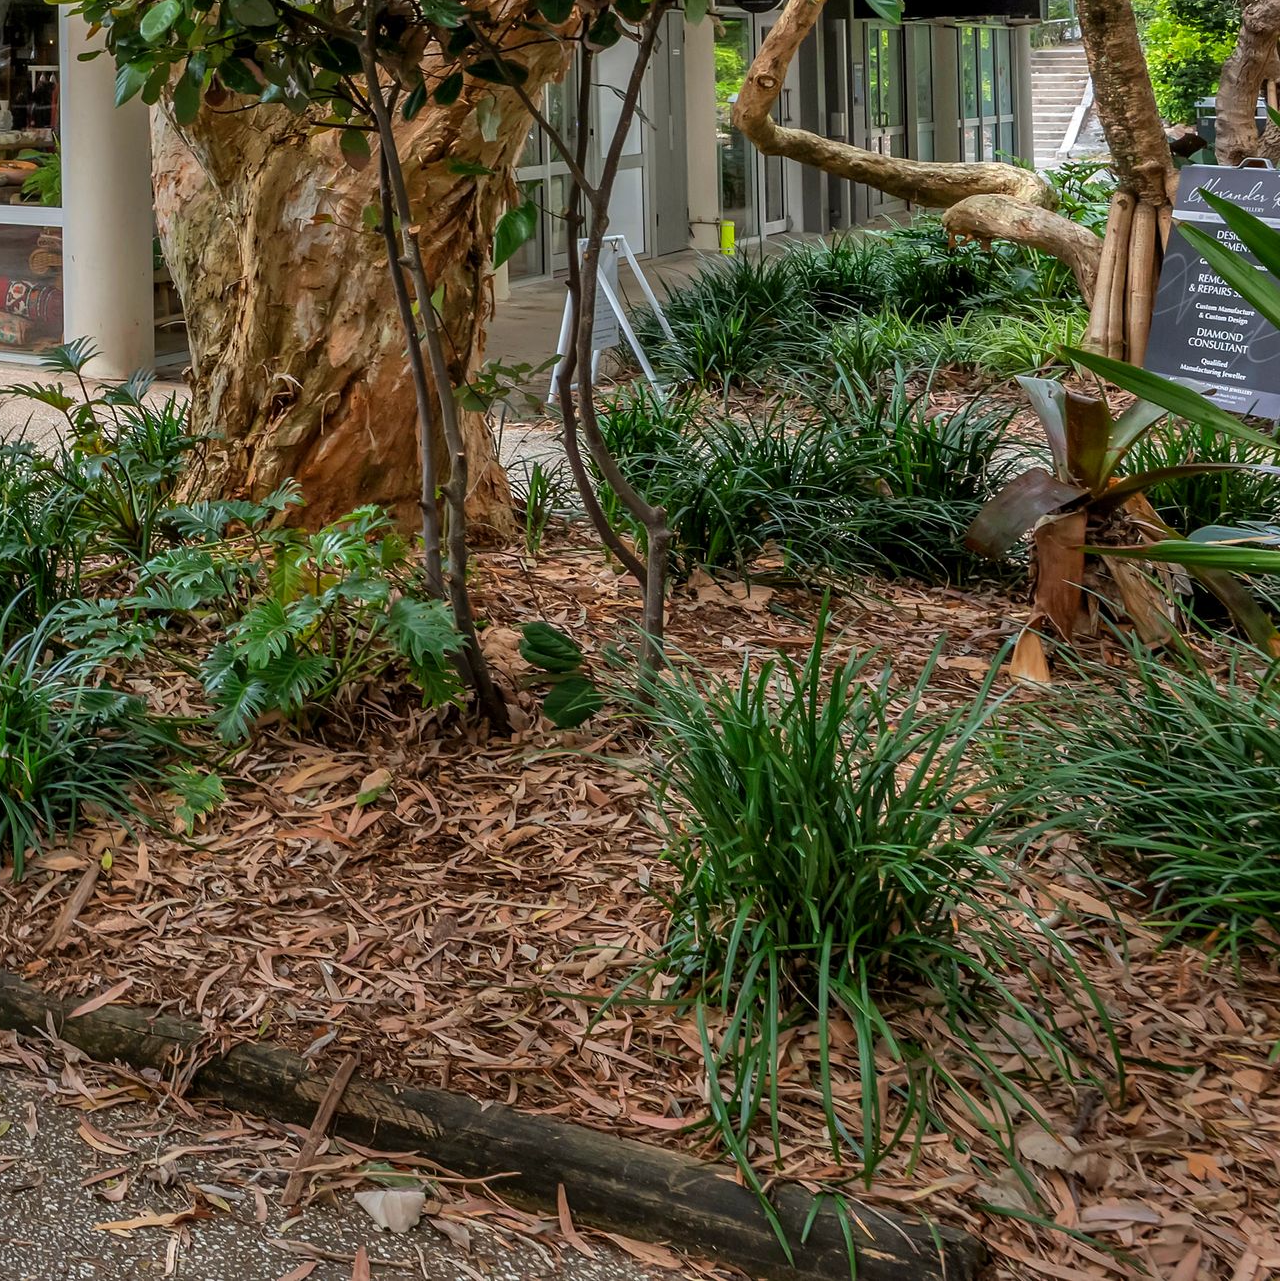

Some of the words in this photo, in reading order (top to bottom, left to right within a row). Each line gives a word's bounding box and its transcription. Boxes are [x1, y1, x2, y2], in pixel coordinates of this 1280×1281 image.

[1188, 283, 1196, 293] &
[1197, 285, 1232, 298] REPAIRS
[1195, 302, 1218, 311] Custom
[1218, 306, 1256, 317] Manufacture
[1204, 313, 1227, 322] Custom
[1227, 316, 1248, 326] Design
[1196, 327, 1244, 343] DIAMOND
[1188, 337, 1249, 355] CONSULTANT
[1200, 358, 1229, 369] Qualified
[1179, 364, 1222, 378] Manufacturing
[1221, 370, 1247, 381] Jeweller
